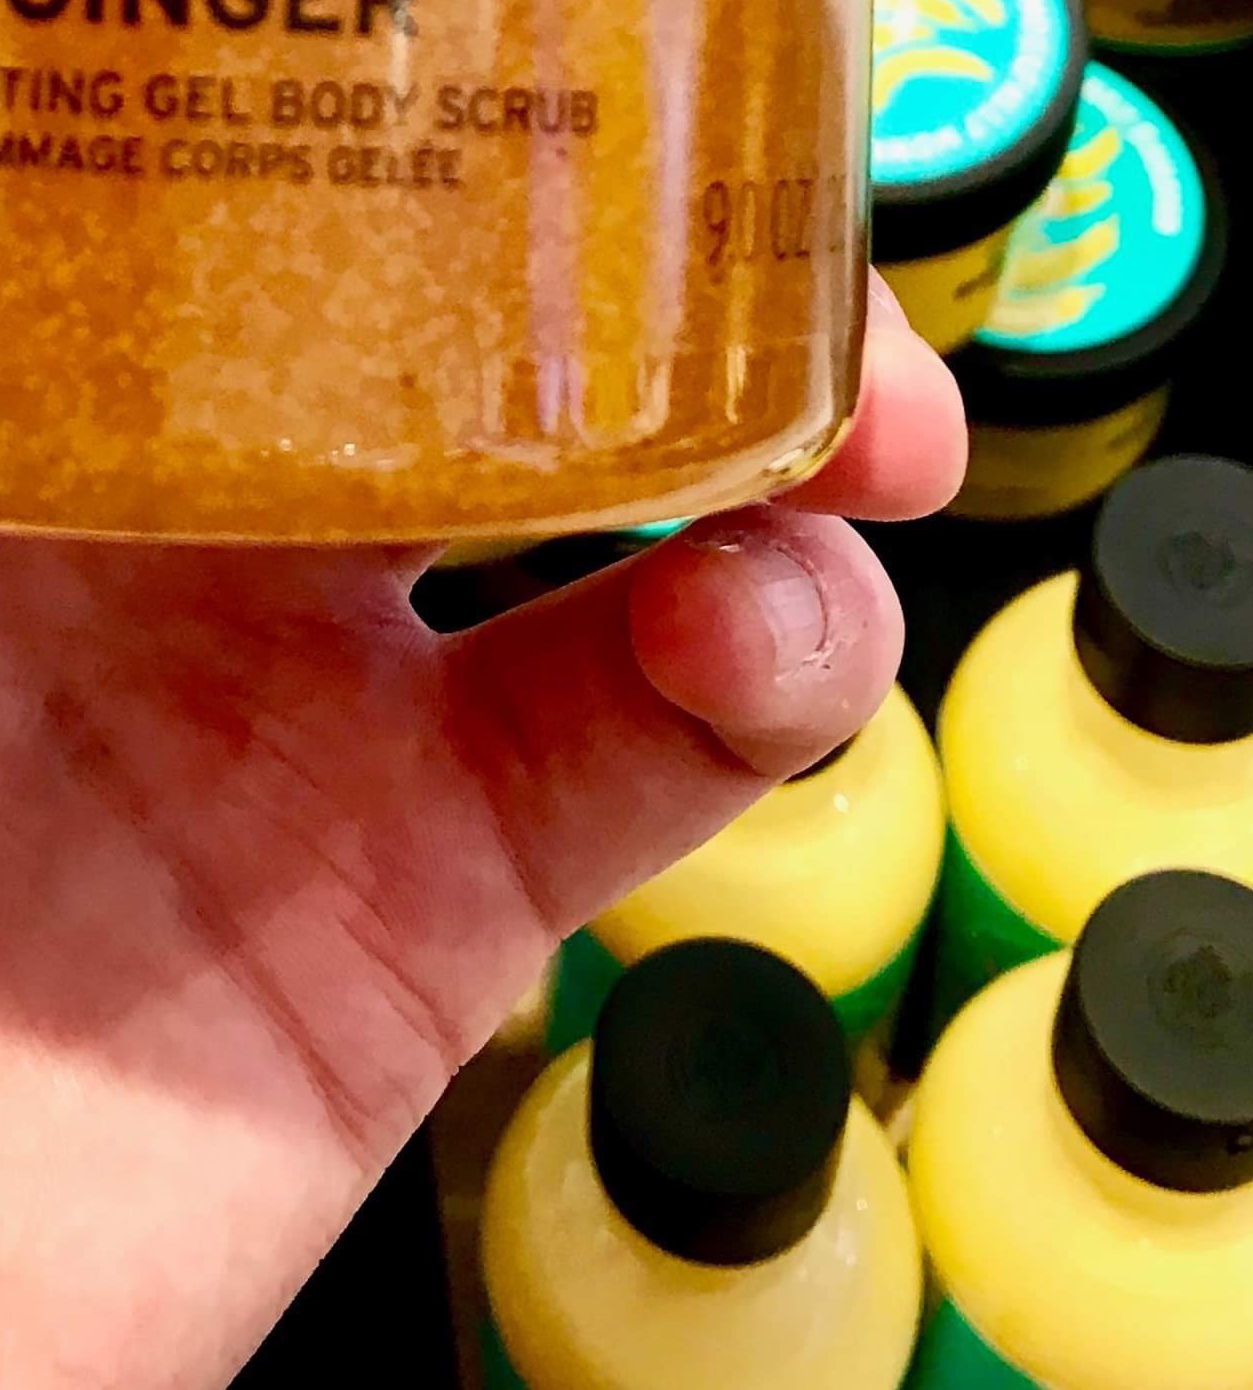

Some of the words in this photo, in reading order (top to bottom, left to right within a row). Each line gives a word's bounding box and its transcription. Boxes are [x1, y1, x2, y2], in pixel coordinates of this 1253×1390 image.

[144, 73, 250, 124] GEL
[271, 78, 420, 130] BODY
[436, 83, 599, 138] SCRUB
[159, 137, 315, 186] CORPS
